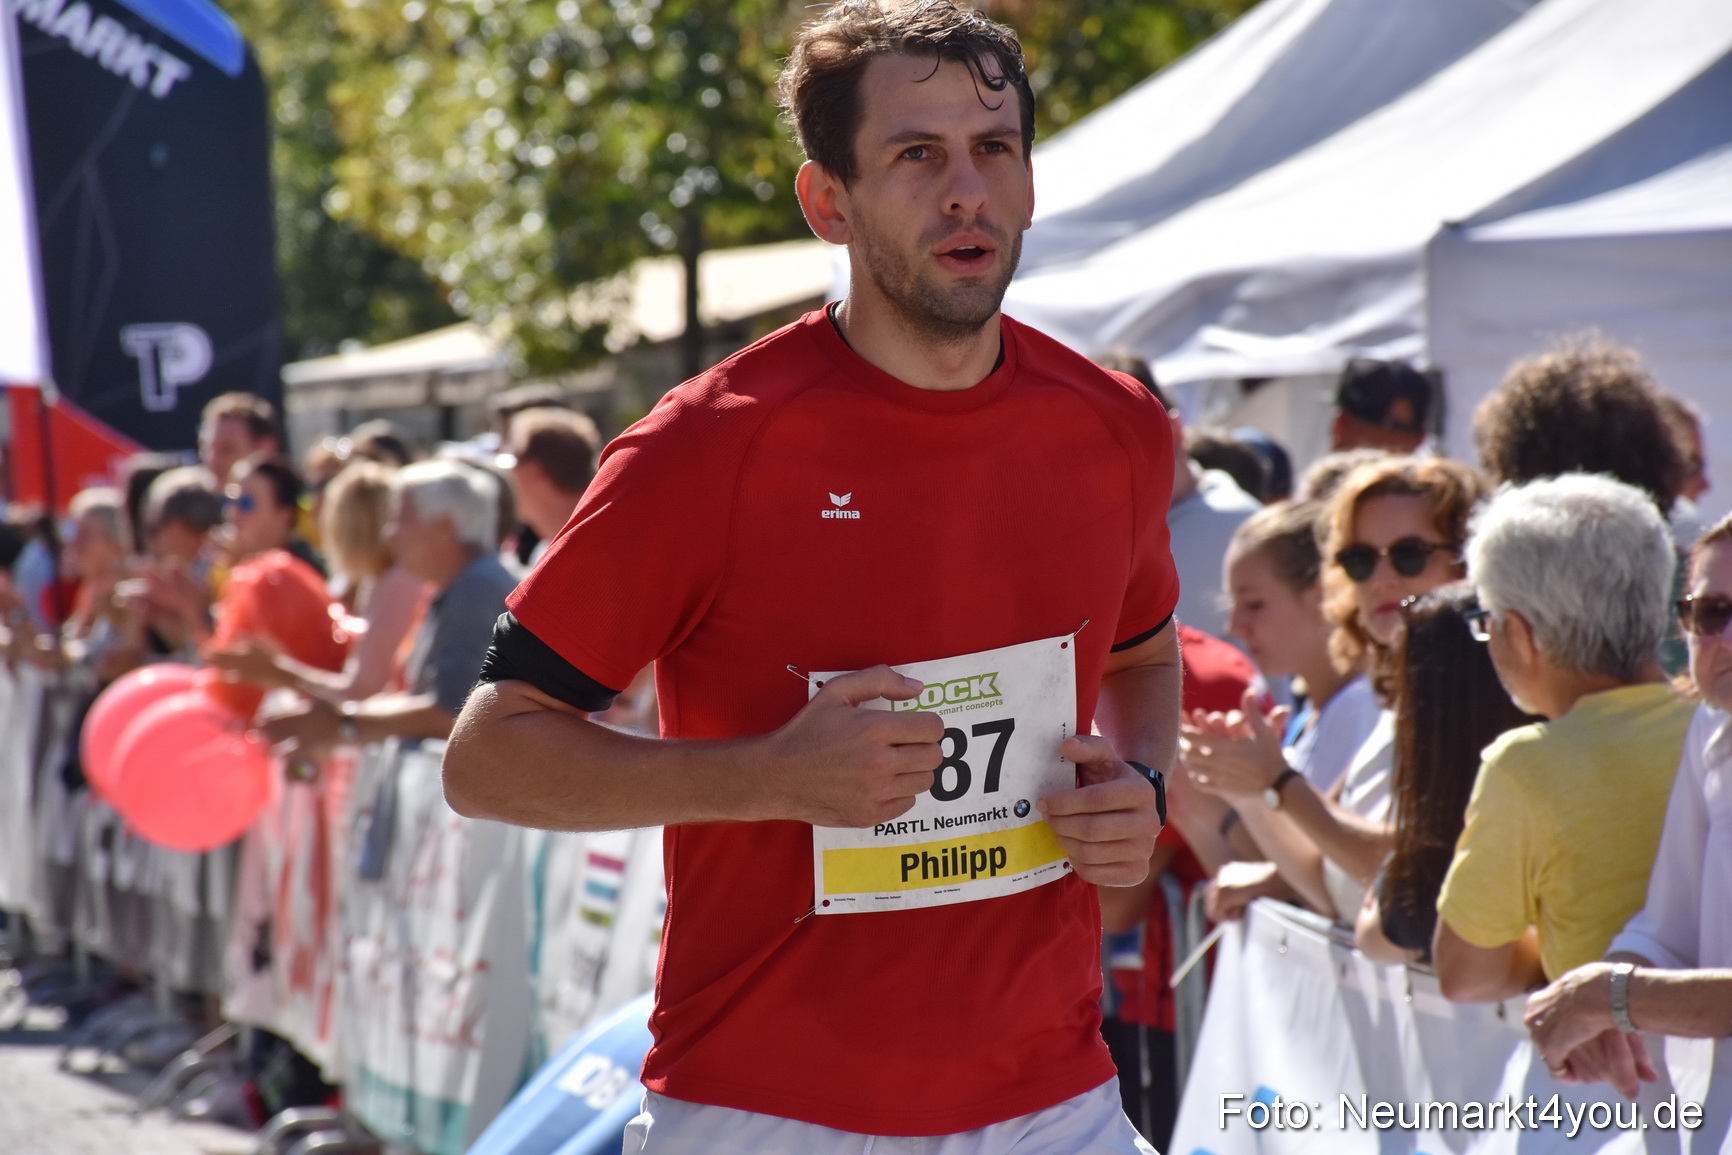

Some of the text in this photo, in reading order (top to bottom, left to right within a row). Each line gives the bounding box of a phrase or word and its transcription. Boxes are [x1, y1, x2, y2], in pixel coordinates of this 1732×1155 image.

[821, 508, 861, 519] erima
[939, 698, 1004, 716] smart concepts
[874, 819, 930, 836] PARTL
[934, 806, 1008, 830] Neumarkt
[901, 844, 1007, 883] Philipp
